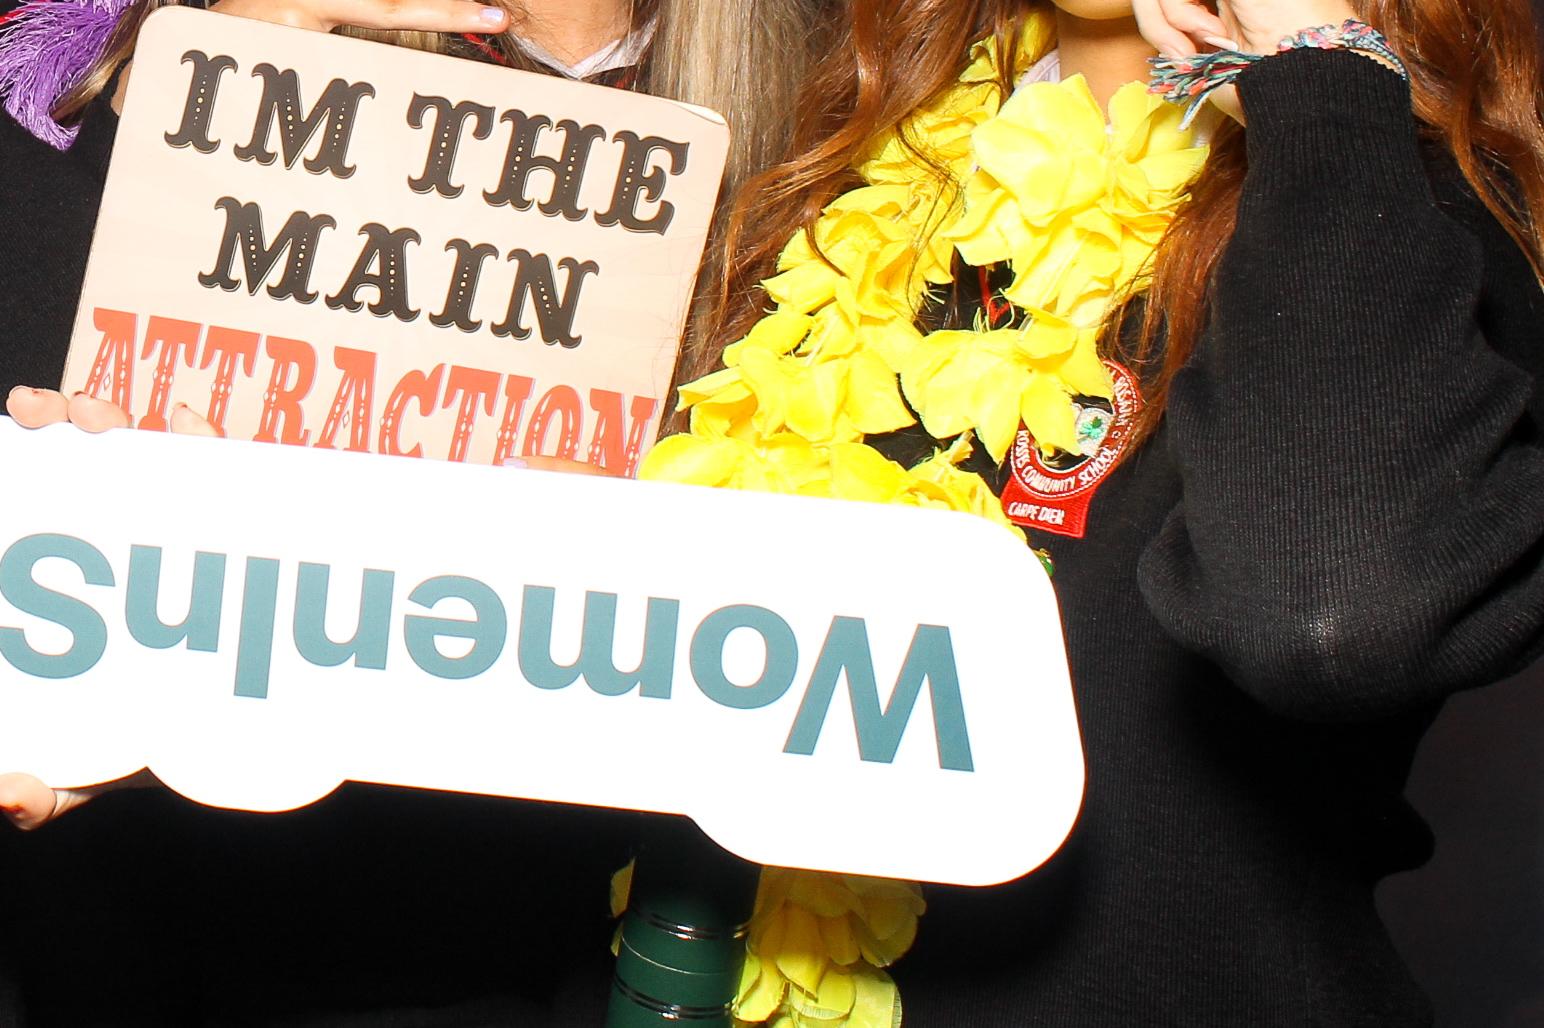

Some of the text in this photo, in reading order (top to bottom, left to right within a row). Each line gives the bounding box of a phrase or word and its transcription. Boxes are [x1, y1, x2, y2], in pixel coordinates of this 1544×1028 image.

[164, 49, 690, 237] IM THE
[197, 196, 599, 349] MAIN
[84, 307, 658, 478] ATTRACTION
[1079, 443, 1118, 486] SCHOOL
[1008, 501, 1040, 521] CARPE
